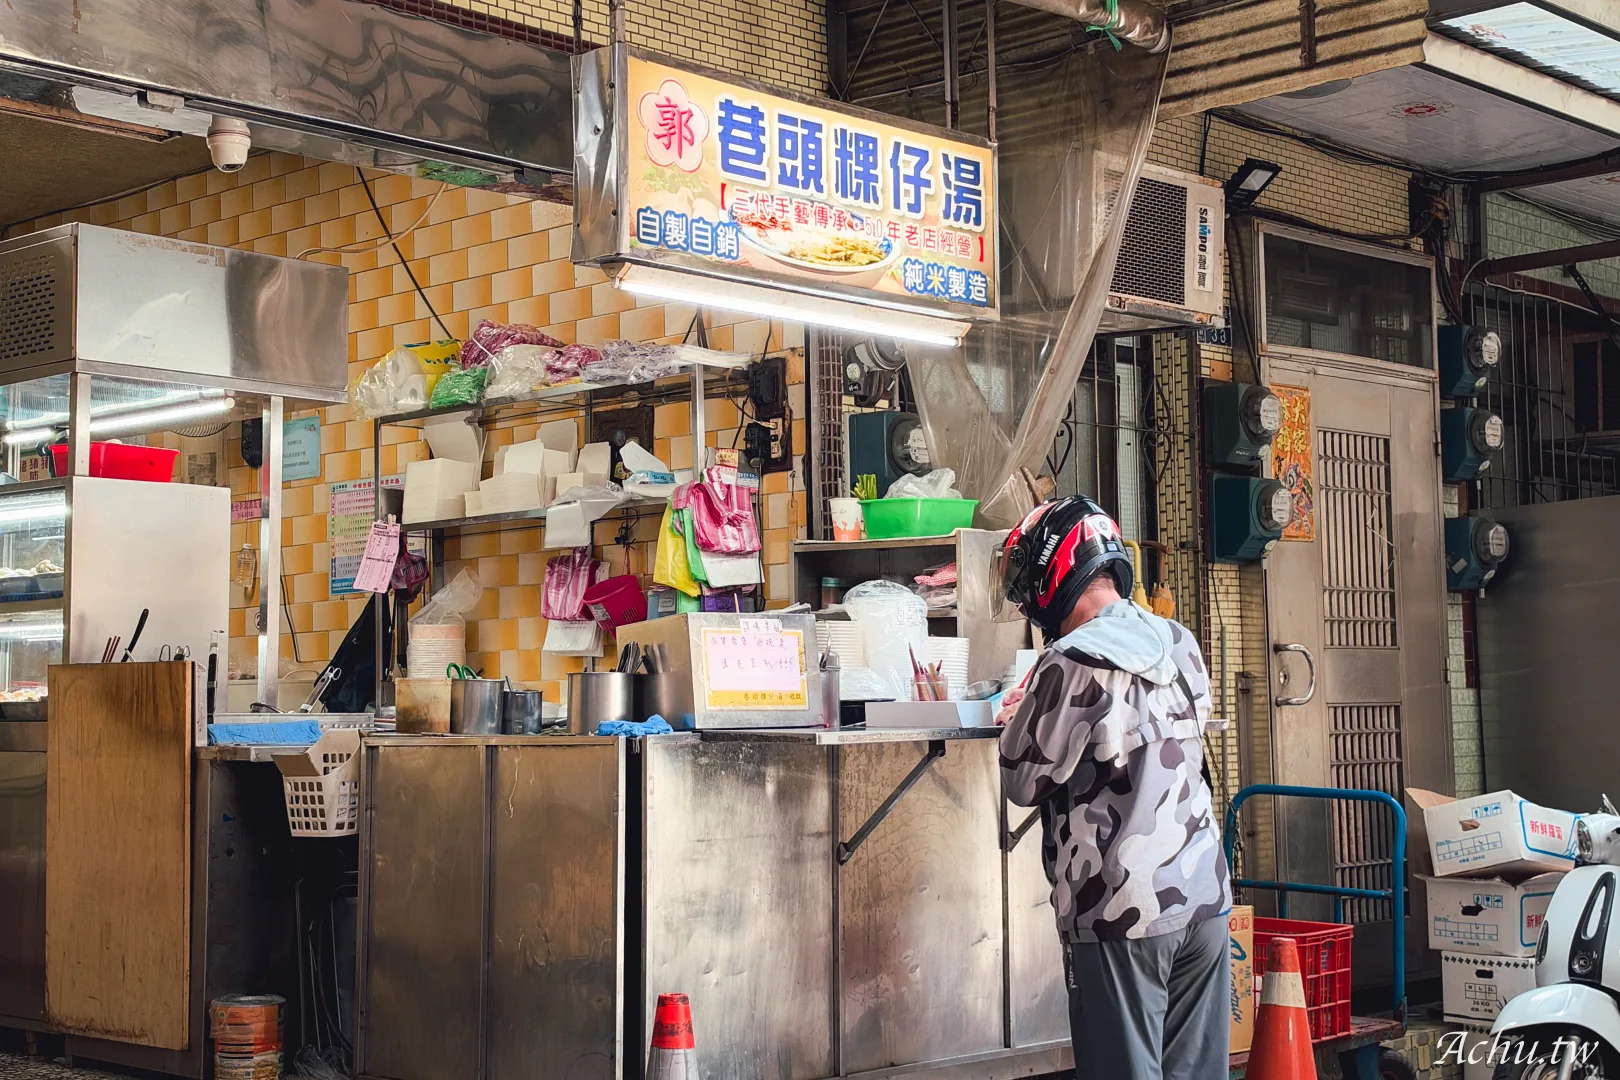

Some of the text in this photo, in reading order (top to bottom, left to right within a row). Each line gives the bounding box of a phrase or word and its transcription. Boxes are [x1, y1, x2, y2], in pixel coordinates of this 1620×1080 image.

[653, 96, 695, 159] 郭
[718, 98, 983, 227] 巷頭粿仔湯
[638, 207, 739, 258] 自製自銷
[1198, 207, 1208, 252] SAMPO
[904, 261, 987, 302] 純米製造
[1037, 534, 1060, 566] YAMAHA
